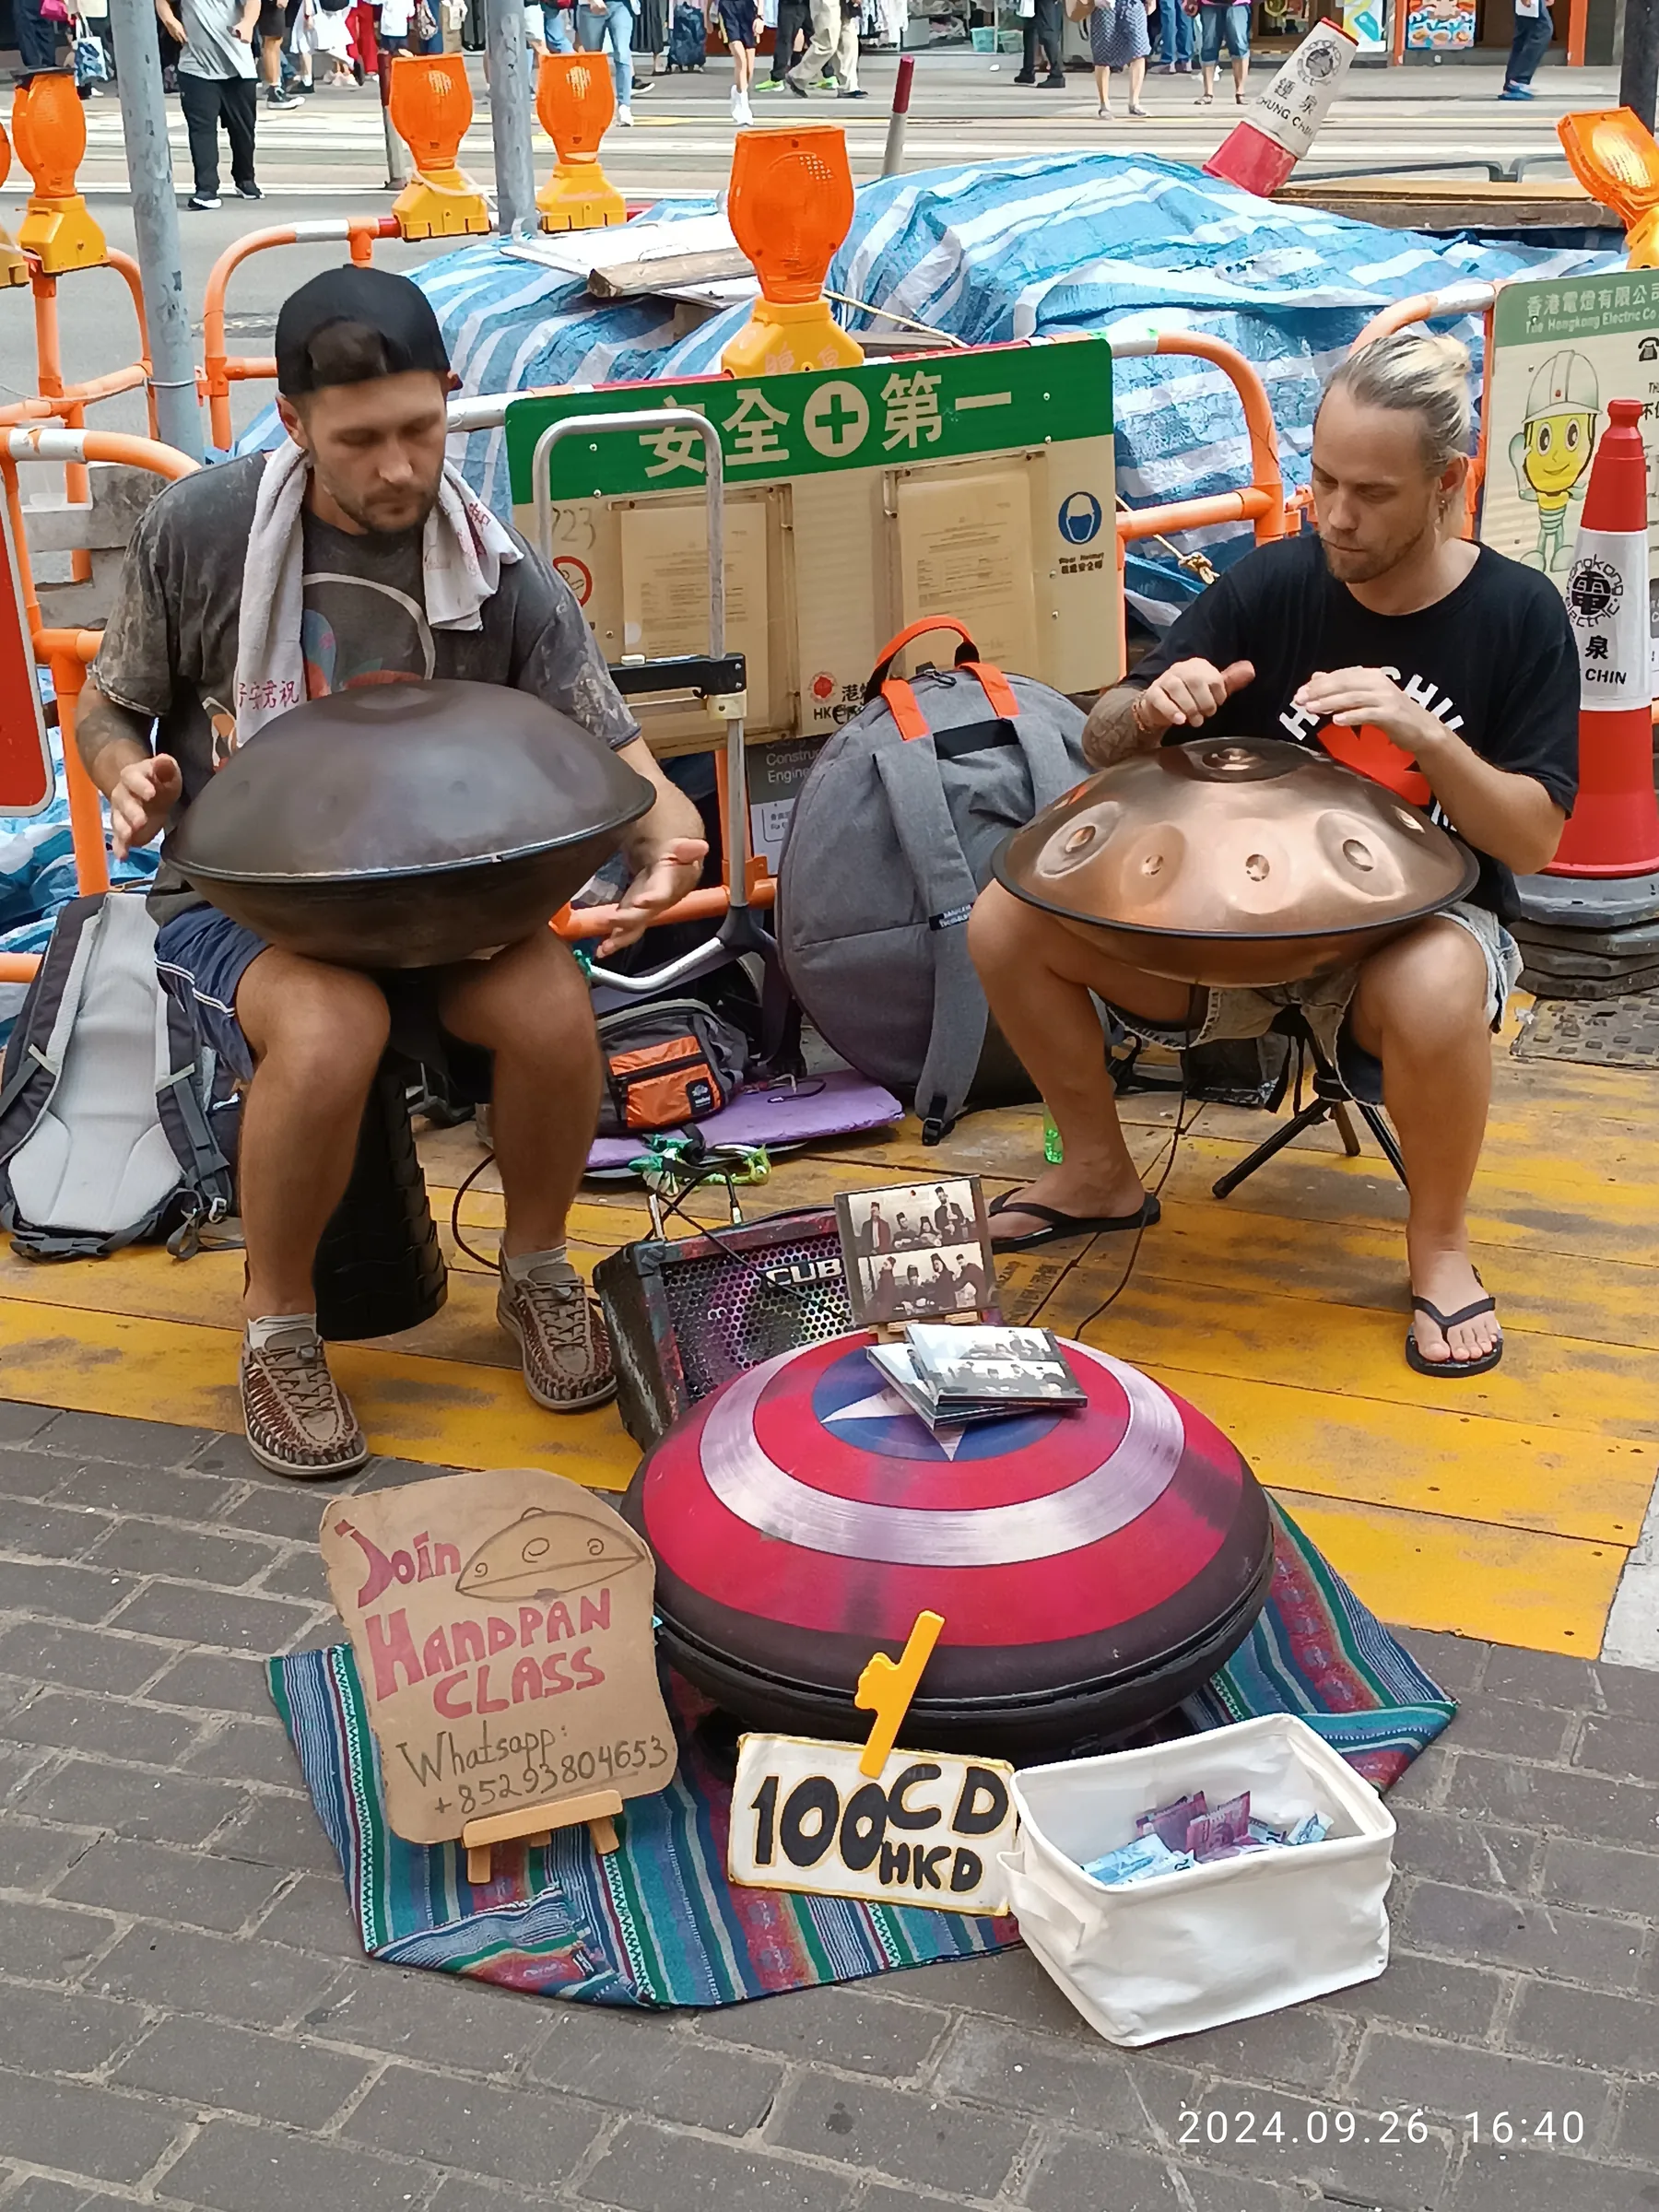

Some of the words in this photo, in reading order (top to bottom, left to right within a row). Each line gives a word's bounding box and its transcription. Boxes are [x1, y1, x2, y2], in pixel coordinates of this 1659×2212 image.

[1603, 307, 1641, 326] Electric
[1584, 634, 1608, 660] 泉
[1584, 668, 1627, 685] CHIN
[334, 1519, 461, 1608] Join
[433, 1646, 606, 1720] CLASS
[751, 1775, 889, 1872] 100
[887, 1762, 1010, 1836] CD
[878, 1840, 983, 1893] HKD
